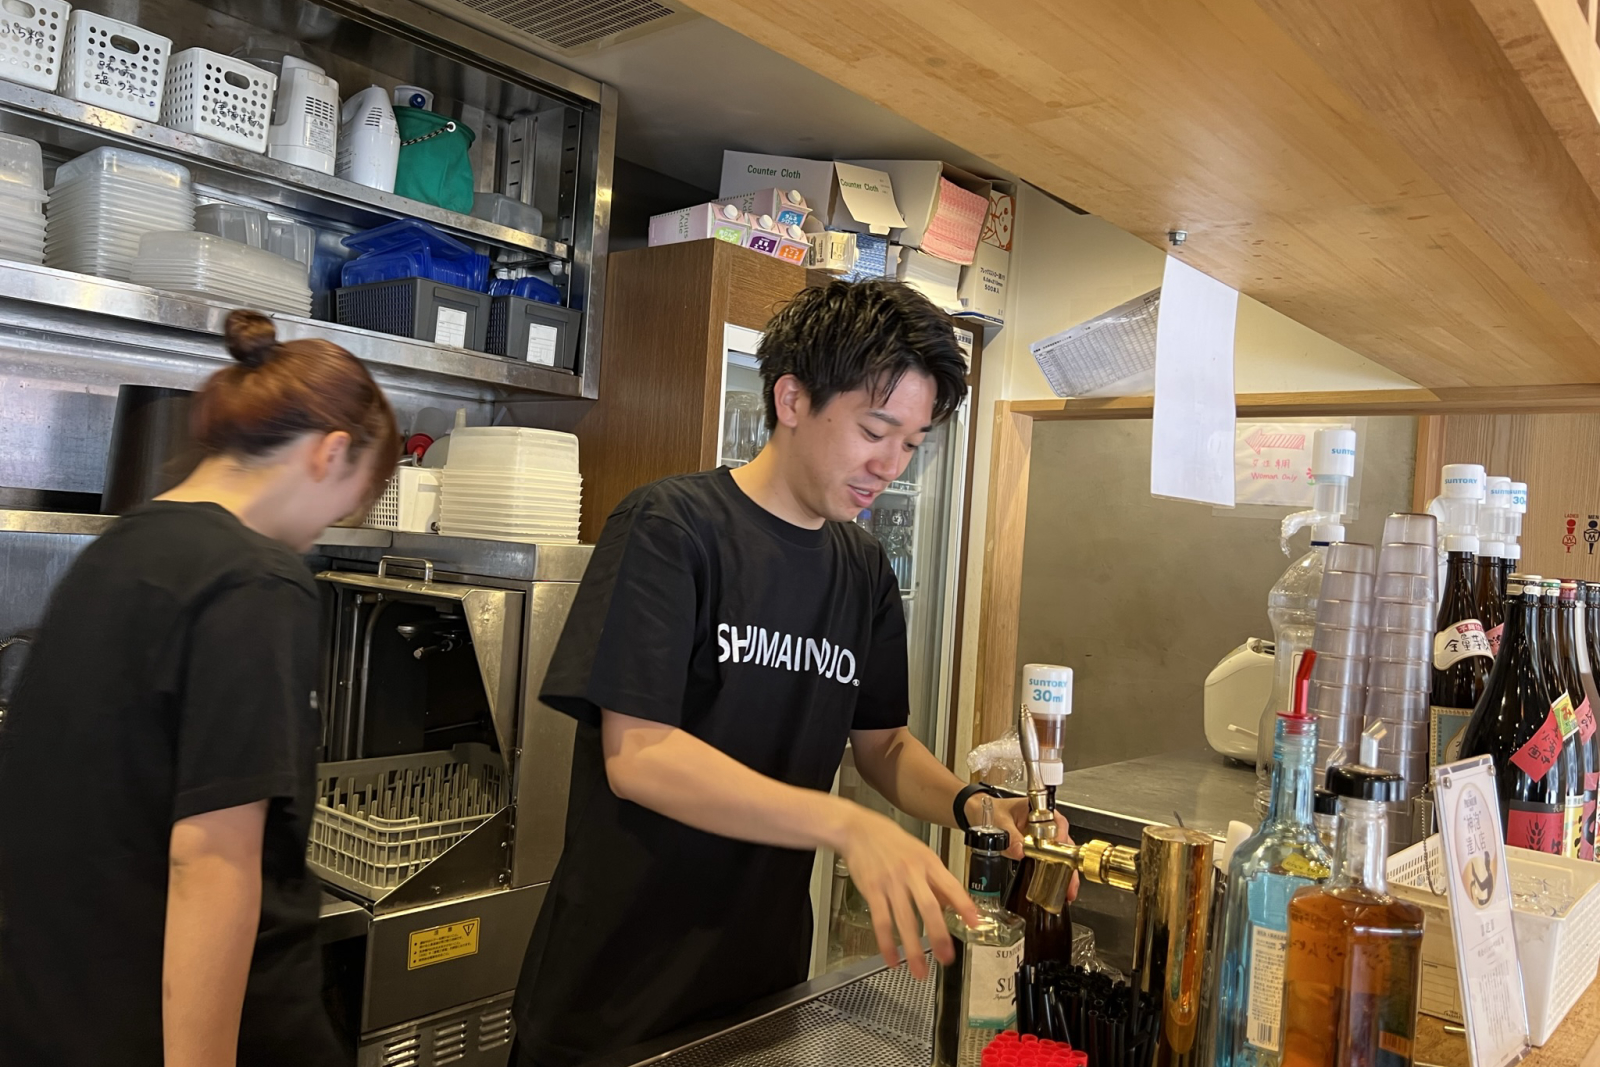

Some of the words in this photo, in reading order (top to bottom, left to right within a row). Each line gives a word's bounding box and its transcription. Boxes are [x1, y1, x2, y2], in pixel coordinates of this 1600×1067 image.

[747, 165, 777, 177] Counter
[781, 168, 801, 179] Cloth
[840, 178, 862, 190] Counter
[864, 183, 879, 193] Cloth
[1331, 448, 1355, 456] SUNTO
[1282, 473, 1298, 483] Only
[1513, 496, 1527, 505] 30
[1029, 678, 1067, 688] SUNTORY
[1033, 688, 1063, 702] 30ml
[996, 975, 1014, 993] SU
